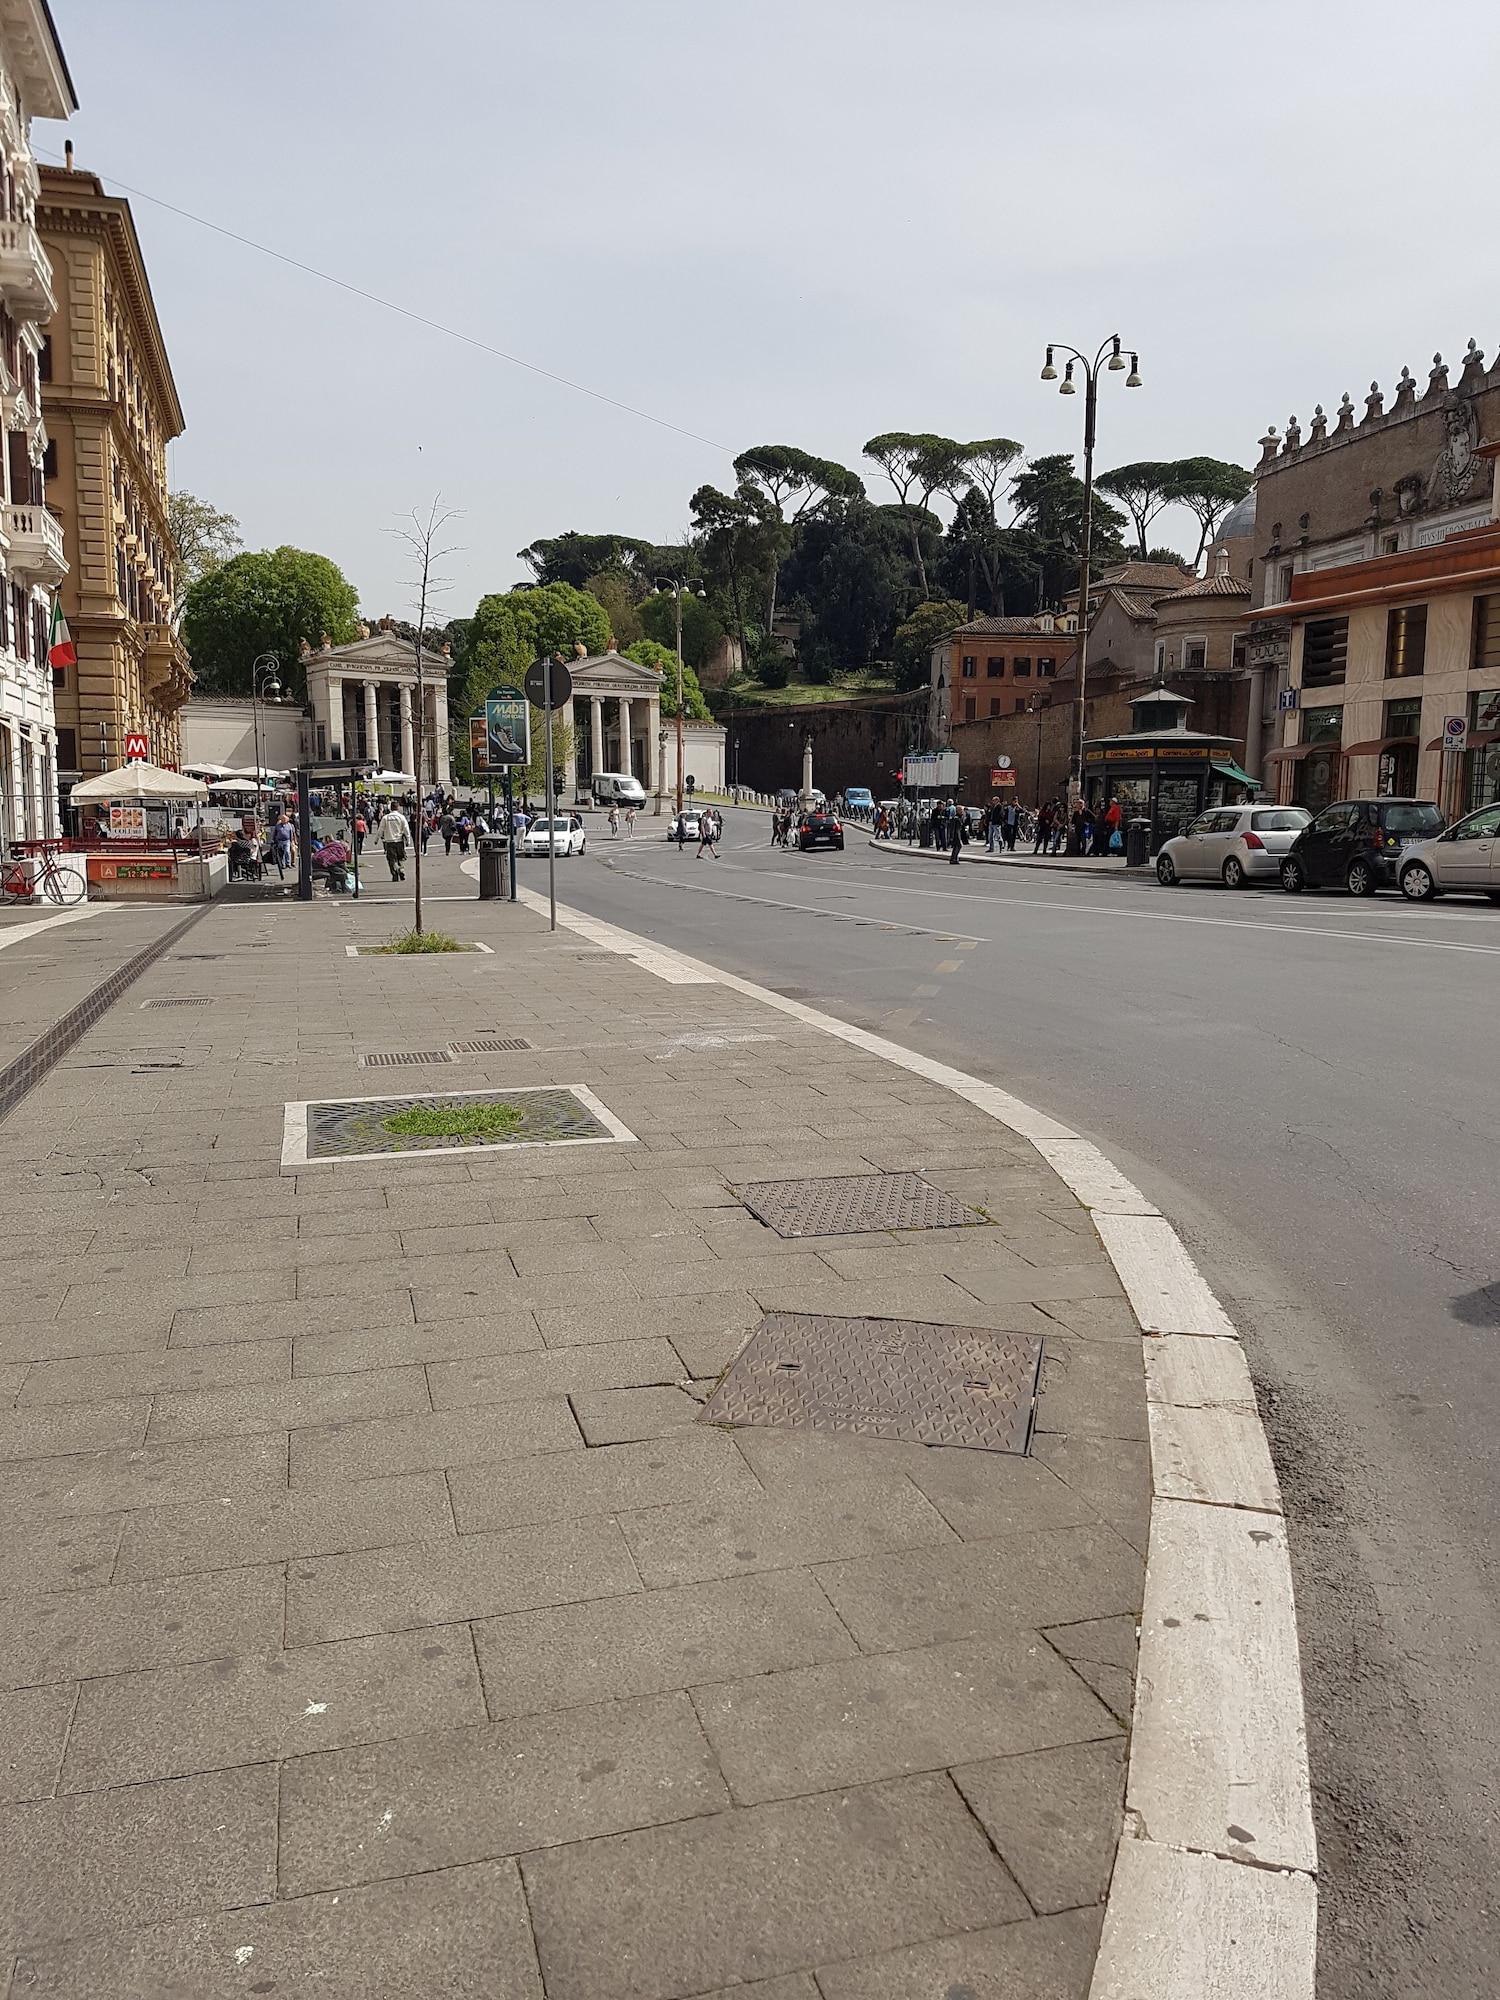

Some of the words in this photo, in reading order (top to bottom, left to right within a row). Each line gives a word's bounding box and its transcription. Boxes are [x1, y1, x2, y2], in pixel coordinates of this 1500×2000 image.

[1283, 691, 1292, 707] T
[492, 703, 525, 714] MADE
[127, 738, 147, 753] M
[105, 867, 113, 876] A
[128, 870, 149, 878] 12:34
